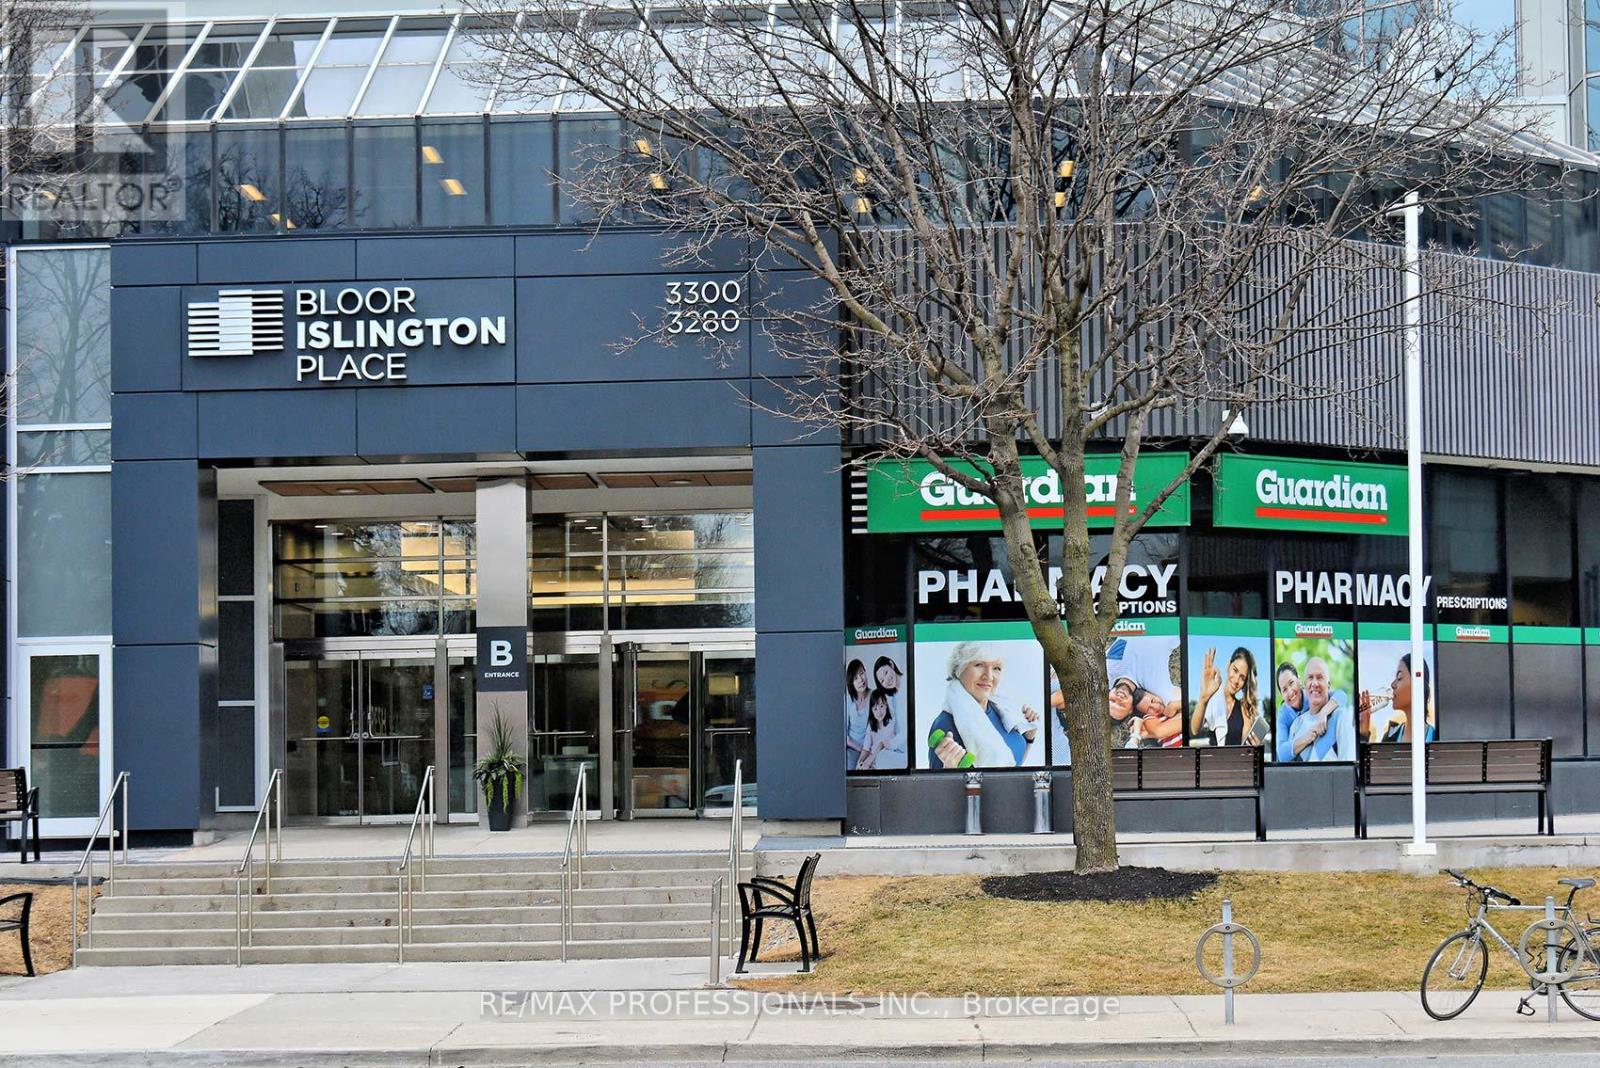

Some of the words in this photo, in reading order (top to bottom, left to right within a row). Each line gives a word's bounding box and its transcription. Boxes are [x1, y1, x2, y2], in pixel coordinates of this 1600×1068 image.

[296, 287, 416, 316] BLOOR
[666, 281, 741, 304] 3300
[296, 316, 506, 350] ISLINGTON
[667, 310, 740, 334] 3280
[296, 352, 407, 382] PLACE
[1256, 469, 1388, 511] Guardian
[1436, 596, 1507, 610] PRESCRIPTIONS
[855, 628, 898, 640] Guardian
[1295, 623, 1333, 634] Guardian
[490, 640, 513, 666] B
